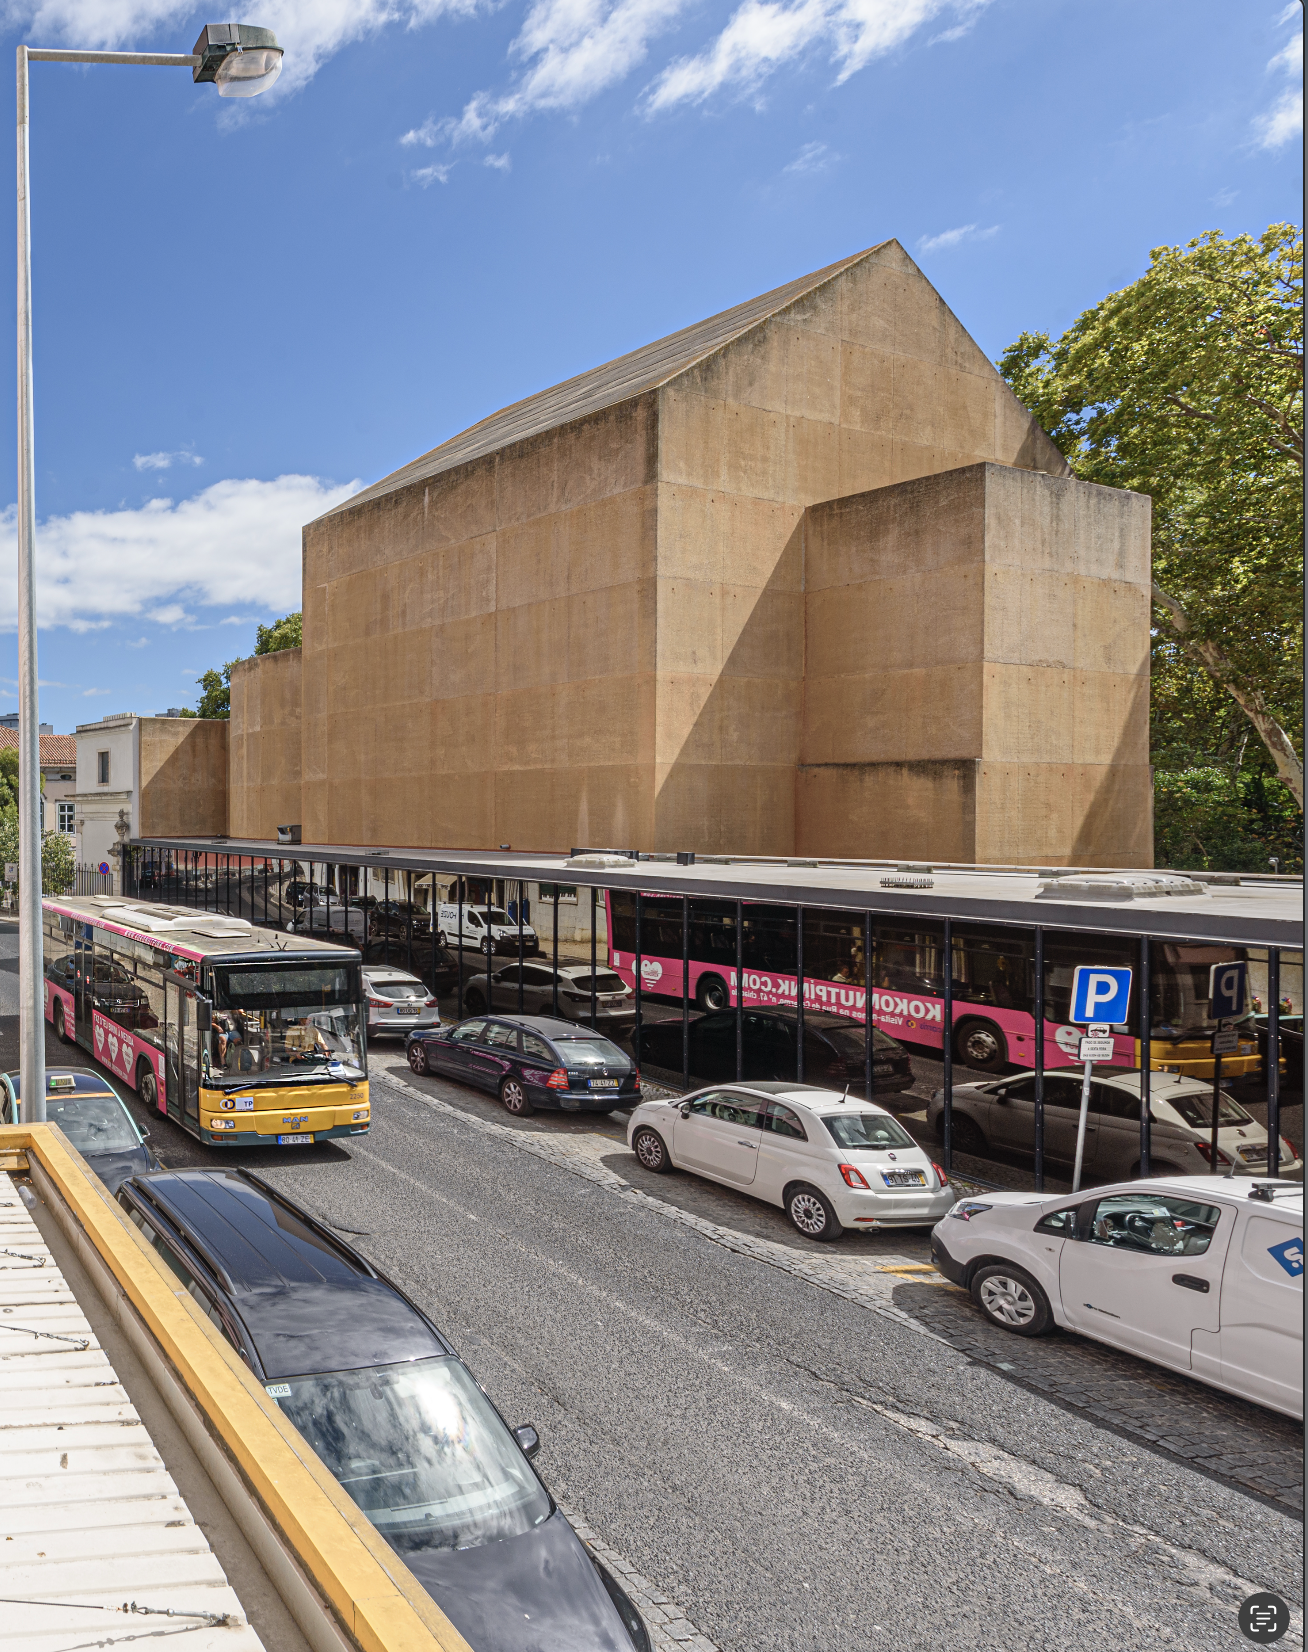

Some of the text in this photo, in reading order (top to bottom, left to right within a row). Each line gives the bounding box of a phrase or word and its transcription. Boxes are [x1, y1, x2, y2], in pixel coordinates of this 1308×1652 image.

[1084, 974, 1119, 1018] P
[282, 1115, 308, 1123] MAN
[268, 1385, 289, 1395] TVDE
